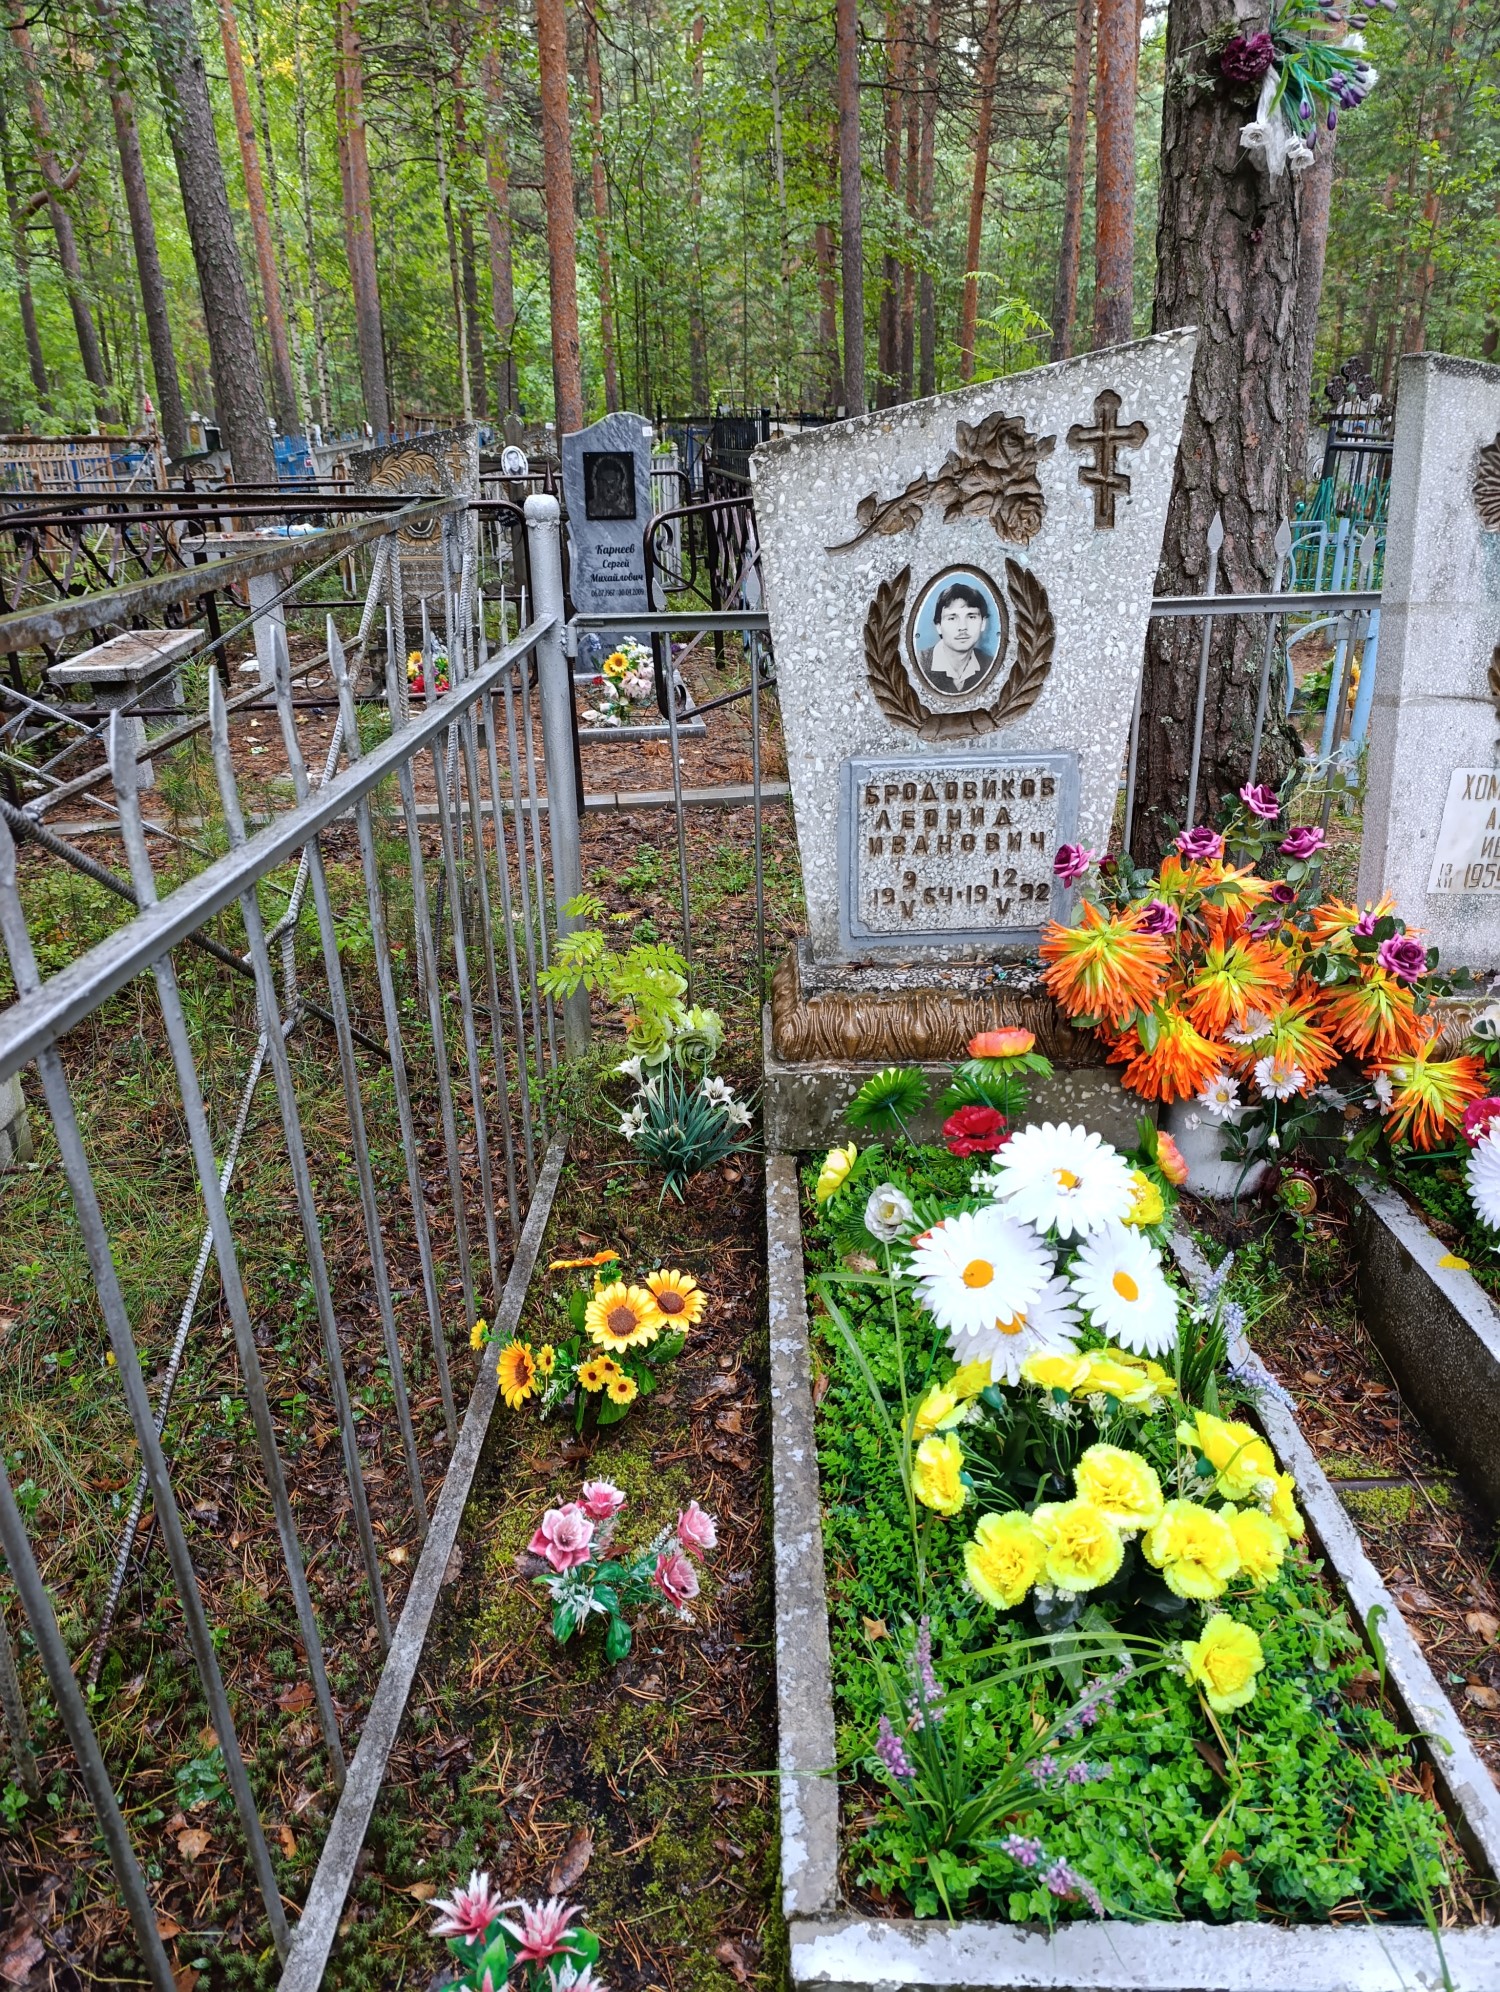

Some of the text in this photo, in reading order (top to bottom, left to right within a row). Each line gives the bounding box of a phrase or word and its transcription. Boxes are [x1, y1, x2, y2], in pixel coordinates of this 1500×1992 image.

[595, 543, 635, 556] Карнеев
[602, 559, 630, 570] Сергей
[590, 573, 643, 582] Михайлович
[865, 778, 1055, 805] БРОДОВИКОВ
[875, 807, 1014, 831] ЛЕОНИД
[869, 832, 1045, 856] ИВАНОВИЧ
